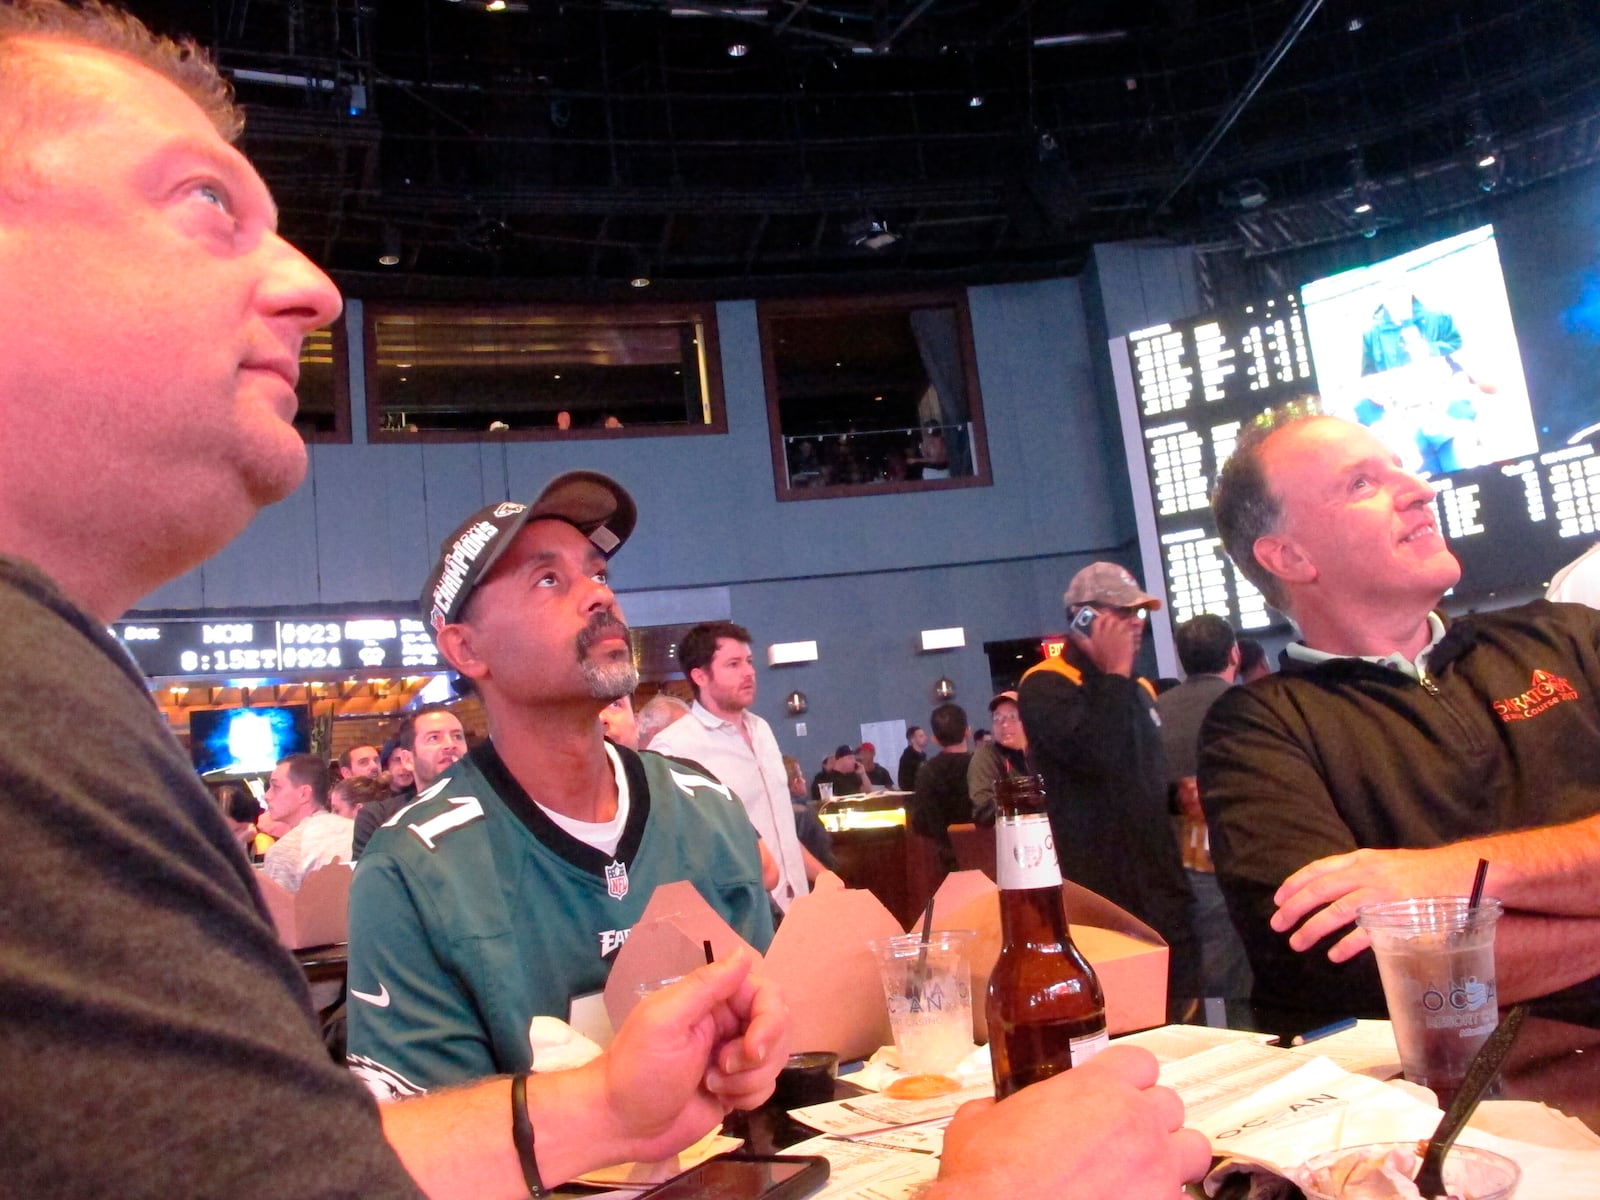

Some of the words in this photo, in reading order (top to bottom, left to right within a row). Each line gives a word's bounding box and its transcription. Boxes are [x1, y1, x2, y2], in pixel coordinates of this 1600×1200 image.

[435, 521, 499, 614] CHAMPIONS
[203, 624, 253, 644] MON
[281, 624, 341, 645] #923
[281, 647, 341, 668] #924
[610, 877, 628, 895] NFL
